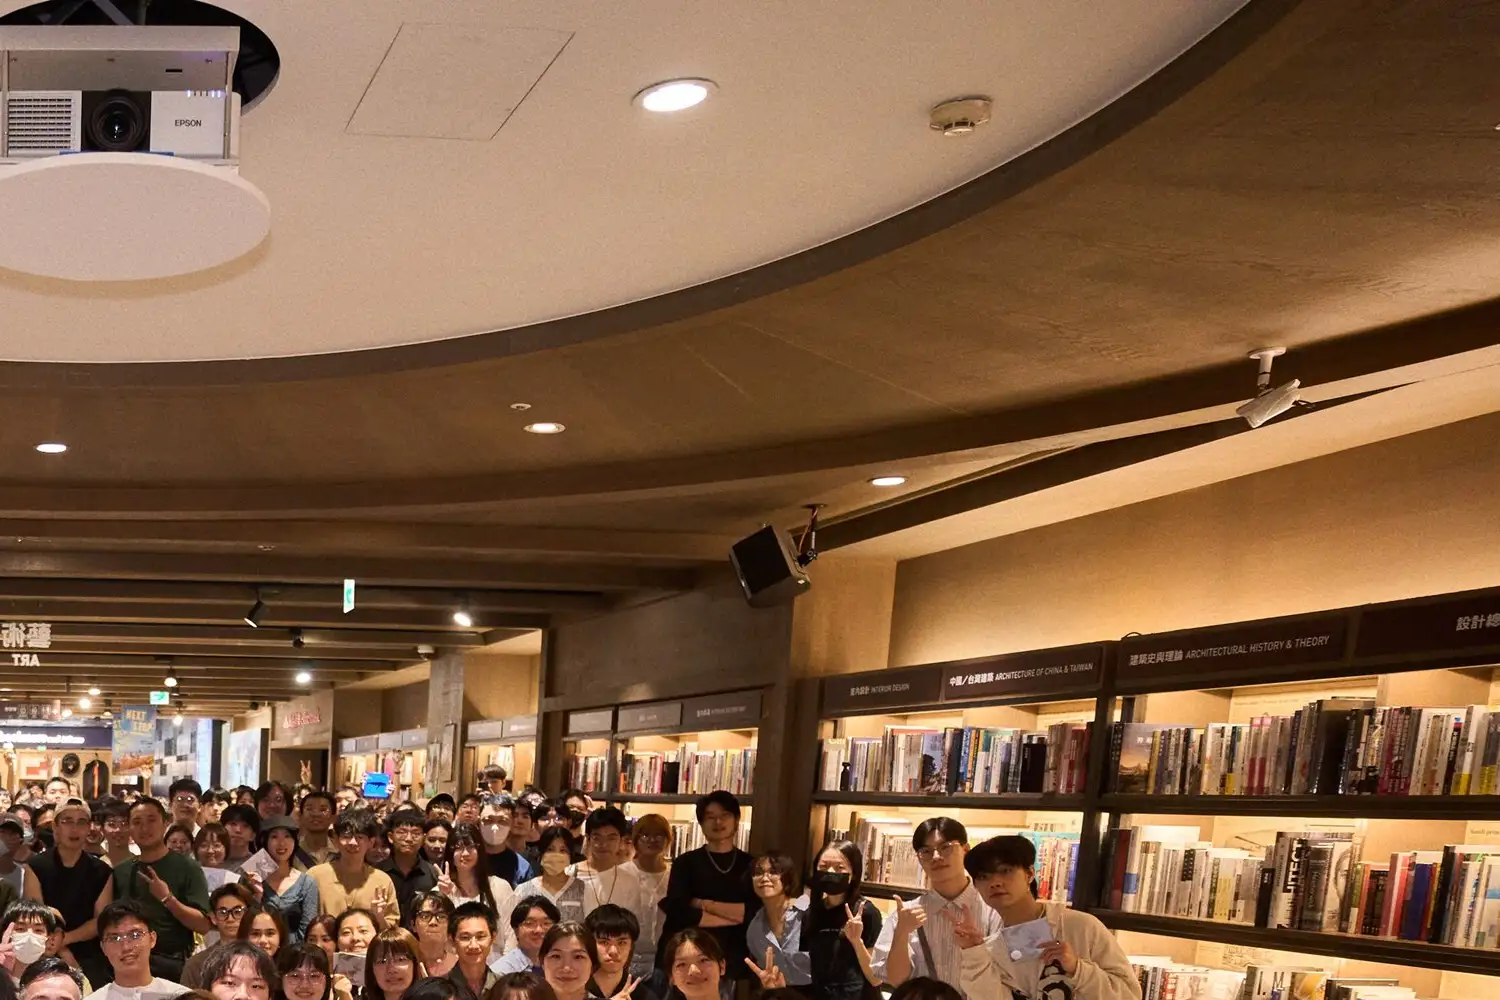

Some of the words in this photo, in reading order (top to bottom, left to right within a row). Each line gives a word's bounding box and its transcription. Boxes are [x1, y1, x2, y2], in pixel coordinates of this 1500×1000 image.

[174, 119, 202, 127] EPSON
[1185, 644, 1248, 660] ARCHITECTURAL
[1250, 640, 1285, 653] HISTORY
[1286, 639, 1293, 648] &
[1295, 635, 1330, 647] THEORY
[995, 668, 1035, 681] ARCHITECTURE
[1036, 667, 1044, 677] OF
[1045, 666, 1063, 675] CHINA
[1064, 665, 1069, 673] &
[1070, 662, 1093, 673] TAIWAN
[893, 683, 910, 692] DESIGN
